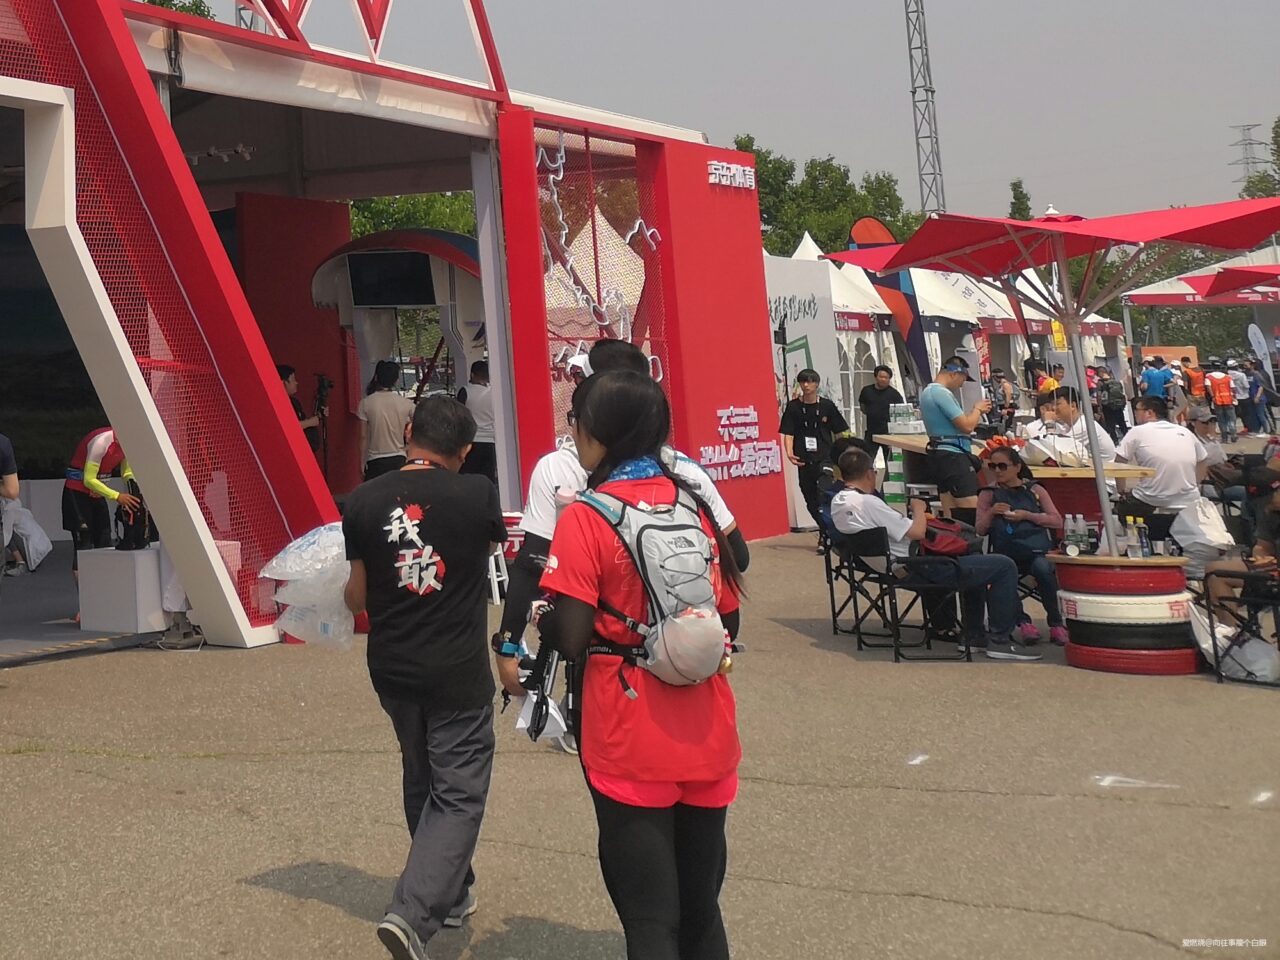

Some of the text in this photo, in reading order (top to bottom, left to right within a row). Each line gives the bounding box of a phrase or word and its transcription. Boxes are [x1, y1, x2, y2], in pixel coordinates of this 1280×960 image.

[706, 160, 756, 190] 京东体育
[716, 405, 759, 442] 不运动
